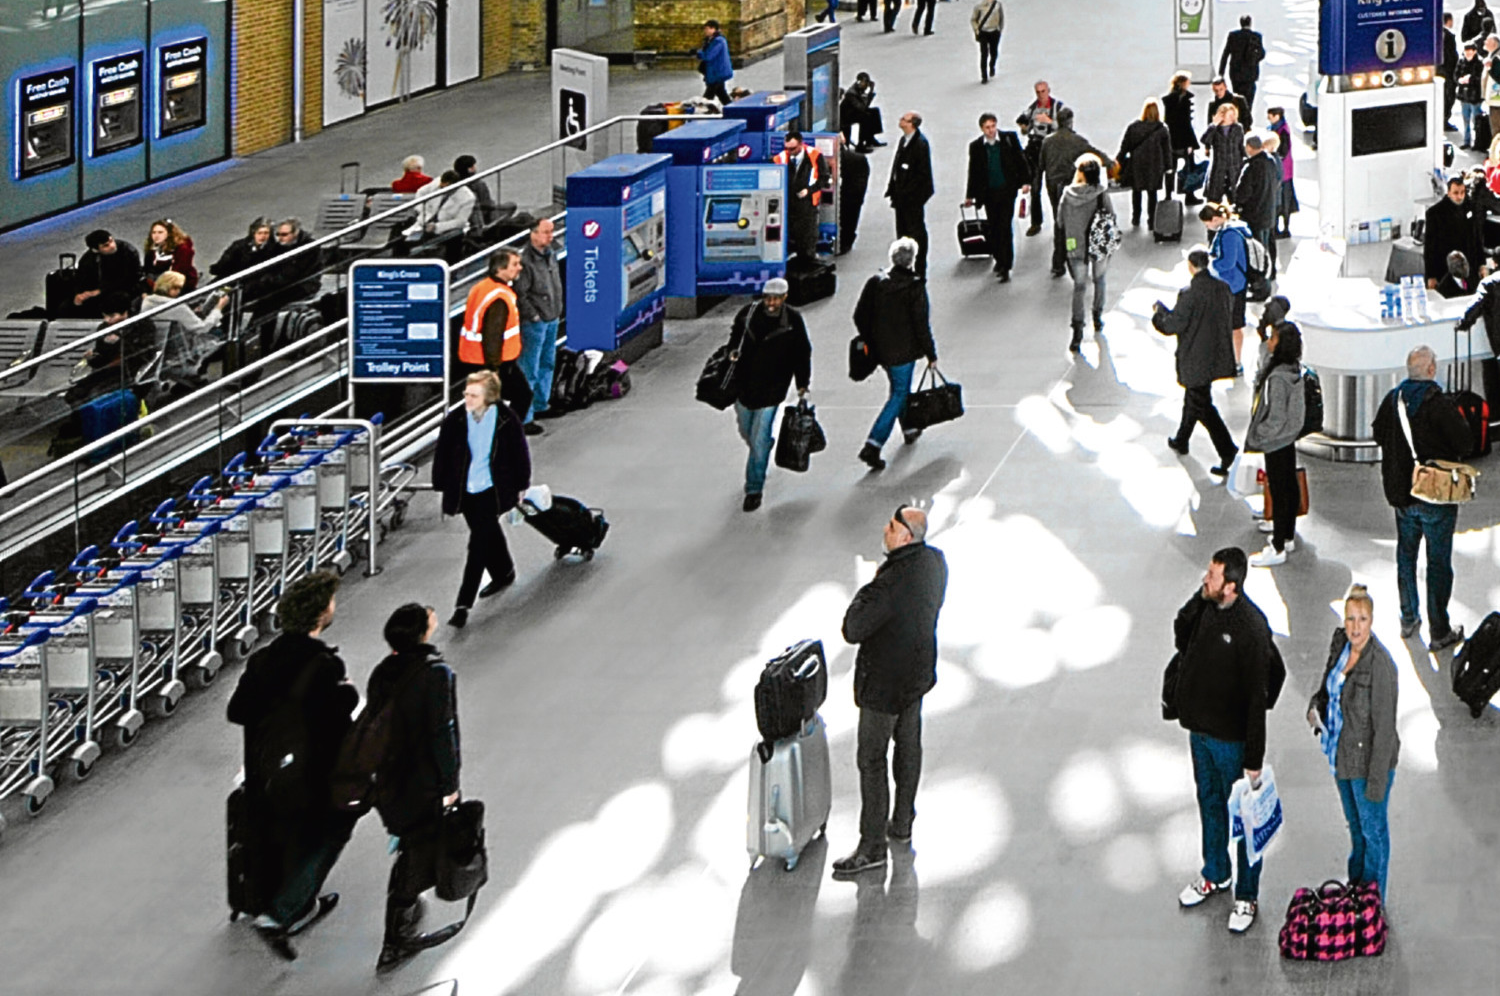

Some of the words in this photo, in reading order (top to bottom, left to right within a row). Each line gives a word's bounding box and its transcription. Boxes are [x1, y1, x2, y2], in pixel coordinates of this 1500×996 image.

[165, 49, 182, 61] Free
[183, 46, 201, 57] Cash
[98, 64, 117, 77] Free
[118, 59, 139, 72] Cash
[26, 82, 47, 95] Free
[48, 75, 69, 89] Cash
[584, 246, 599, 303] Tickets
[366, 362, 400, 374] Trolley
[402, 362, 430, 372] Point
